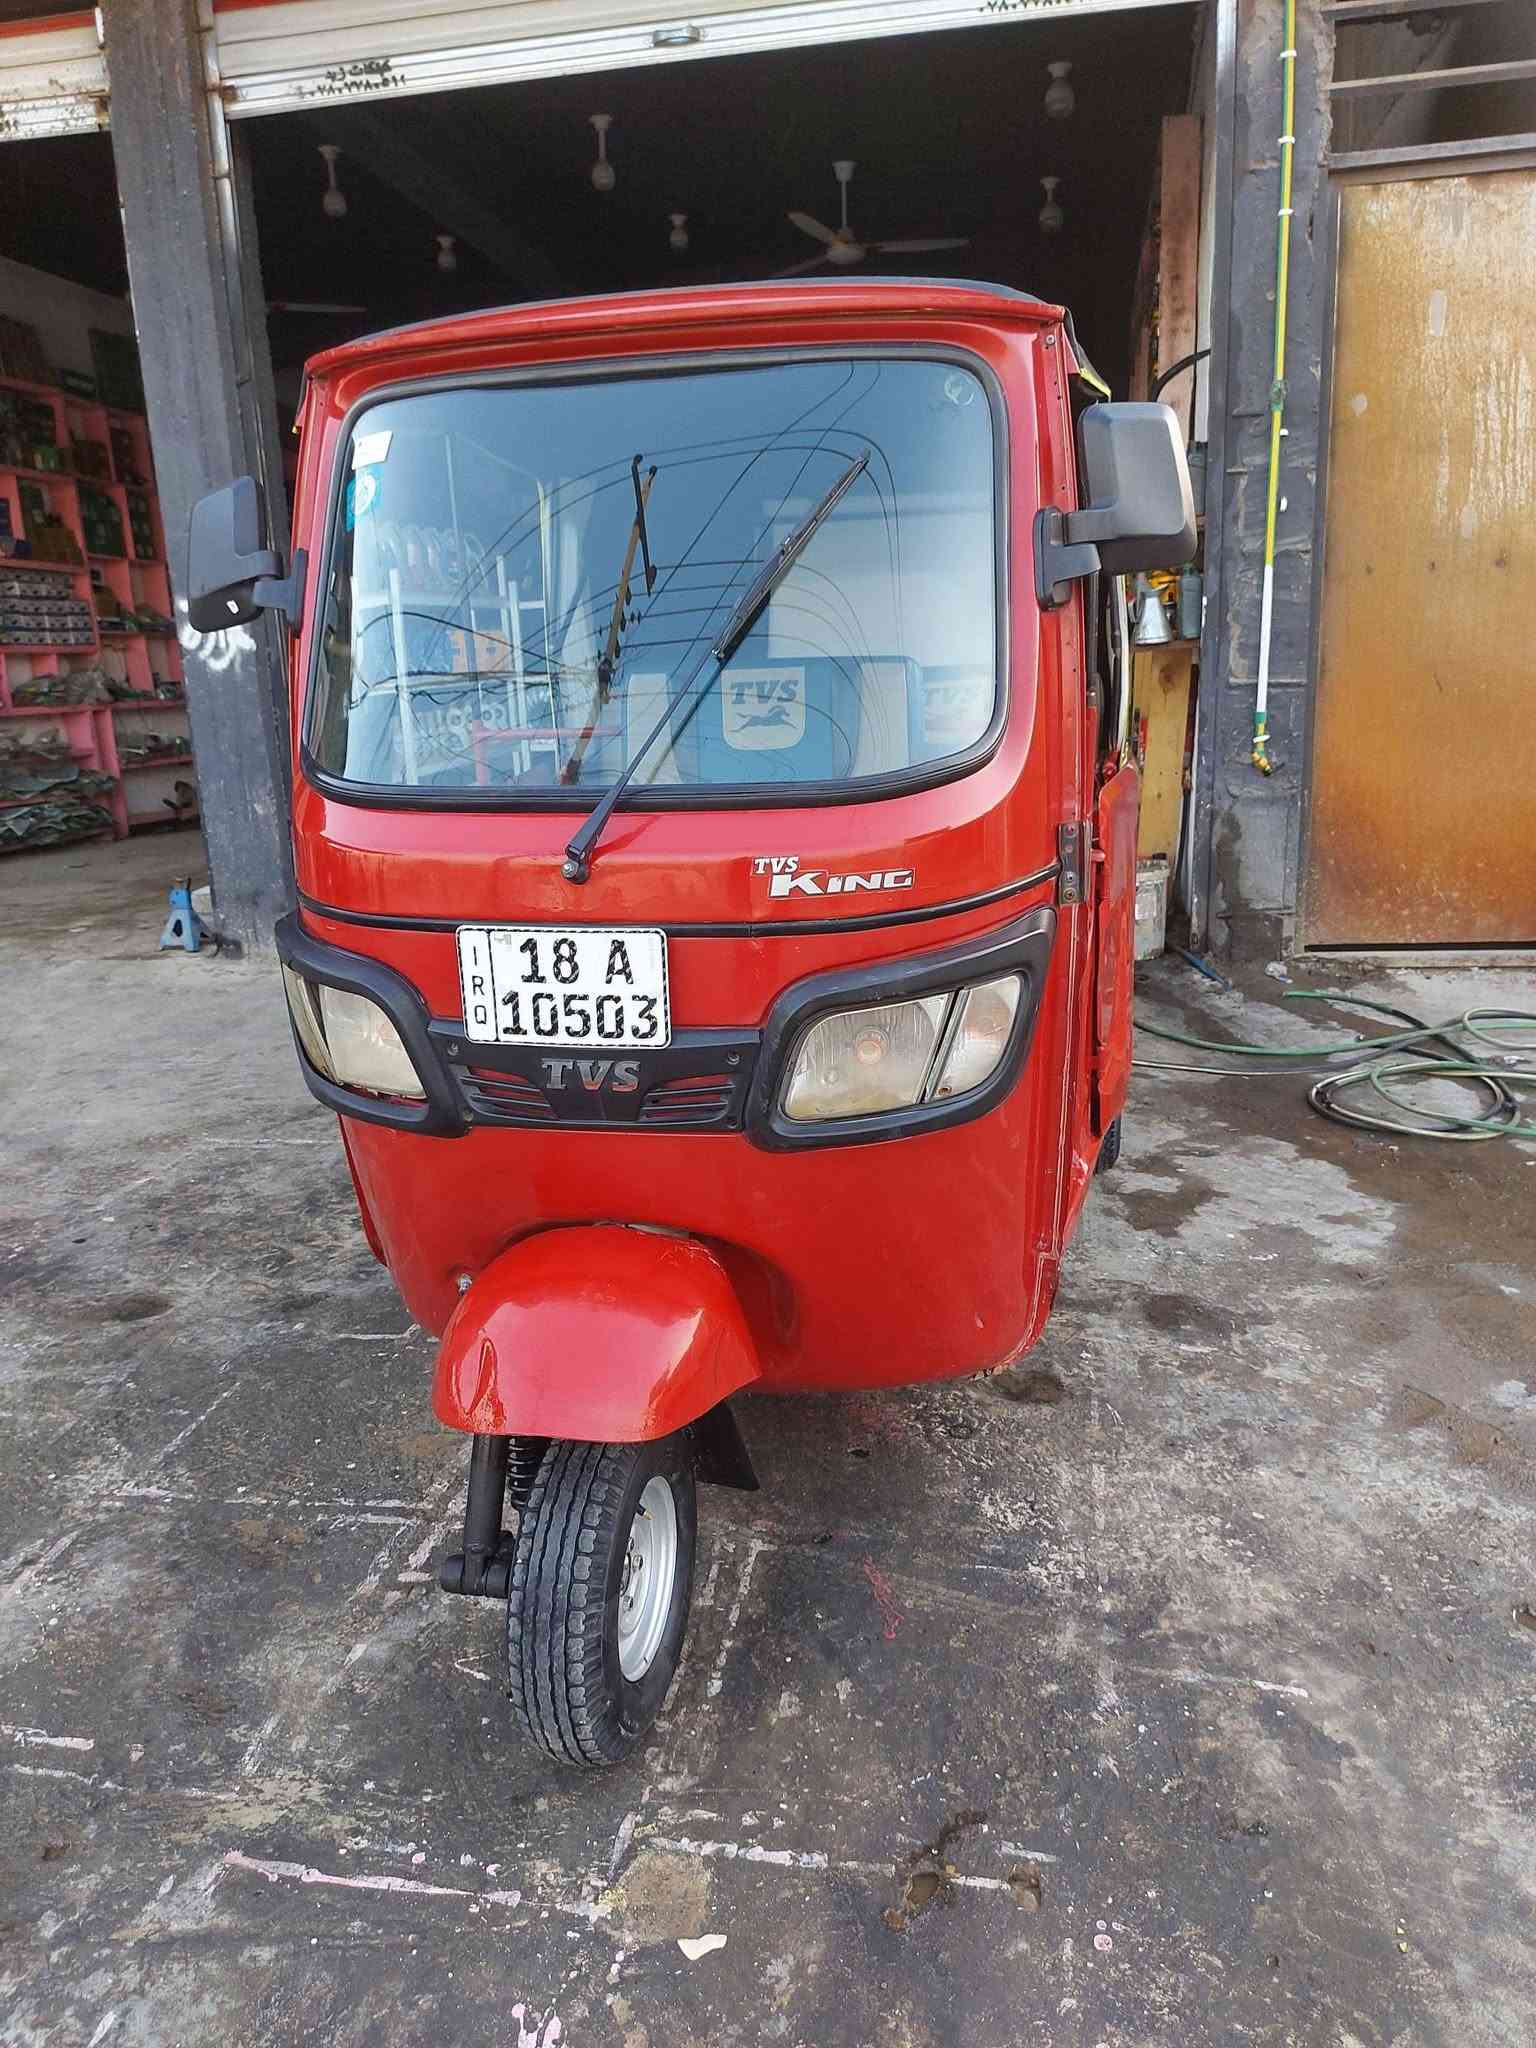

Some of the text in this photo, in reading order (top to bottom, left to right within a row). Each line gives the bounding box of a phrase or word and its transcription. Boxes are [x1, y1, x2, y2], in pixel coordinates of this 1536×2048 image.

[730, 680, 799, 704] TVS
[753, 856, 799, 874] TVS
[769, 869, 913, 897] KING
[519, 937, 634, 985] 18 A
[471, 946, 488, 1024] IRQ
[502, 990, 658, 1039] 10503
[541, 1057, 641, 1092] TVS
